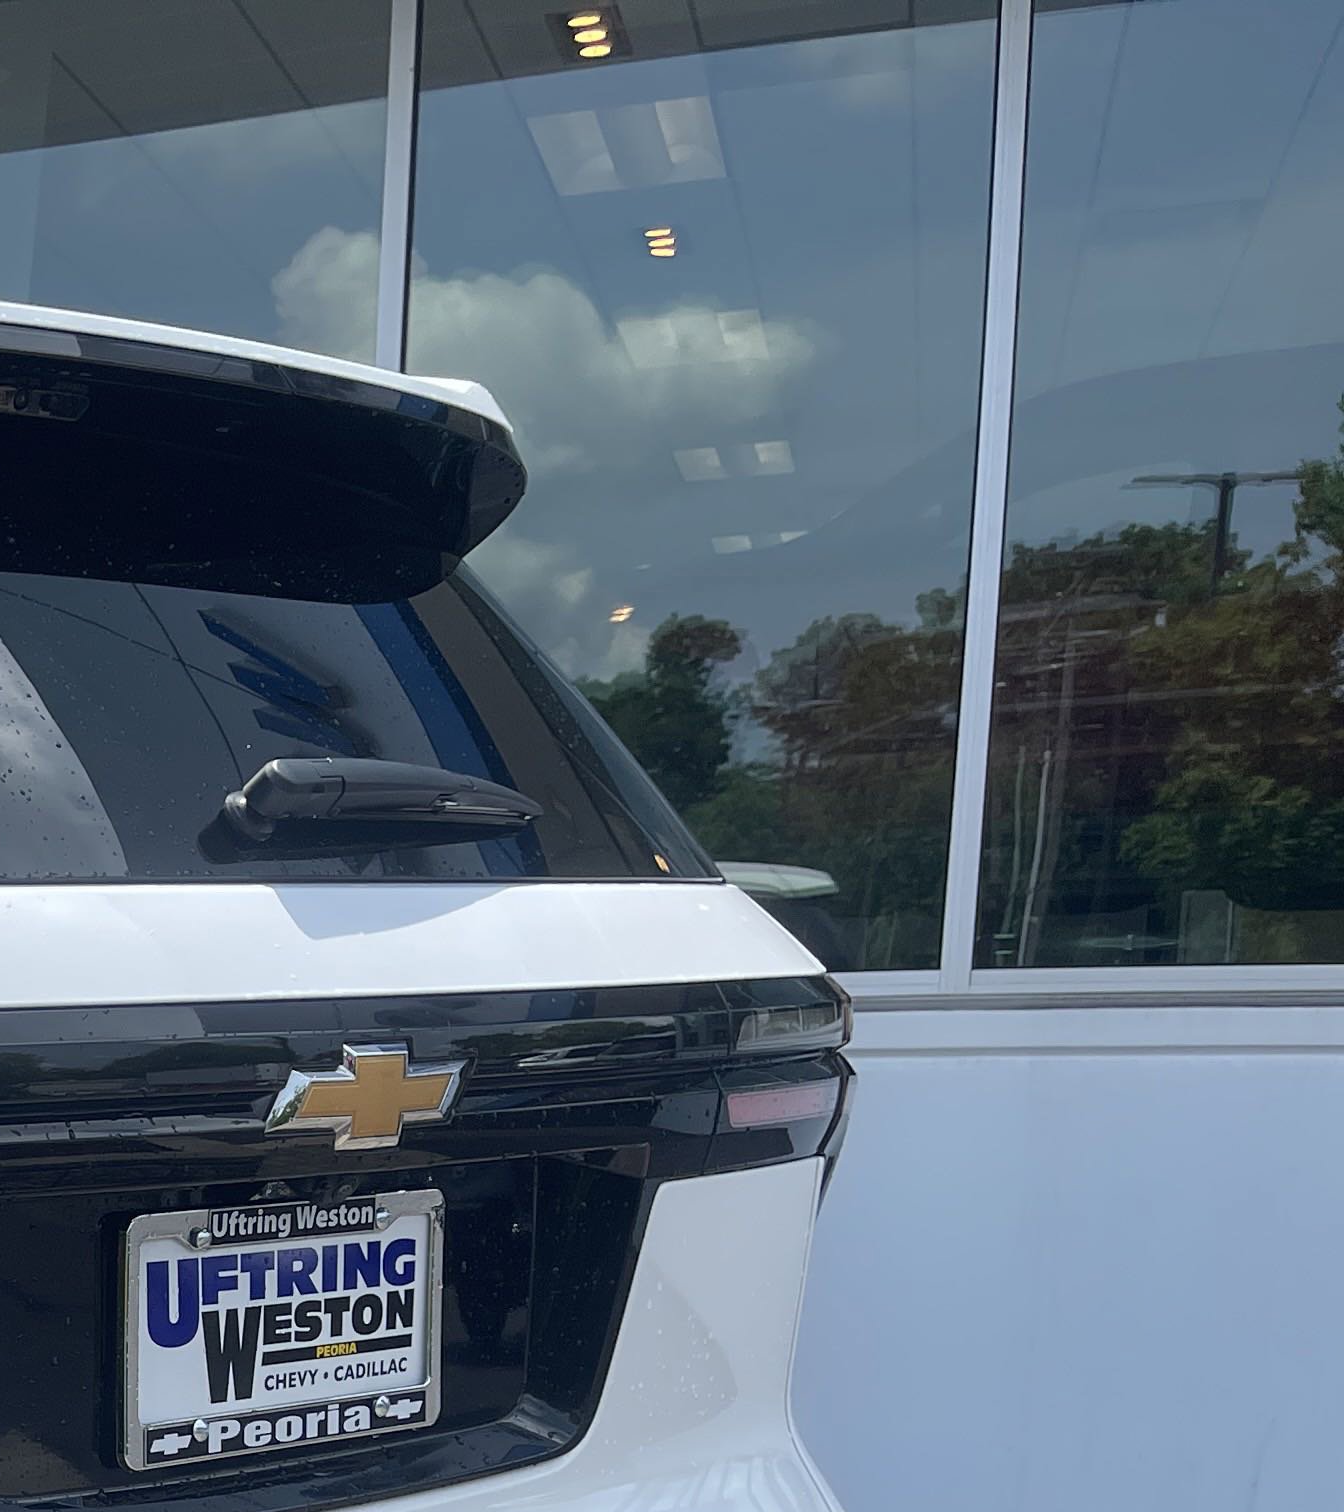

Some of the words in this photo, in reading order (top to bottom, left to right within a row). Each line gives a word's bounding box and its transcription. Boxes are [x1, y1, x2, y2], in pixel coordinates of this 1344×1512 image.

[212, 1208, 291, 1238] Uftring
[296, 1203, 374, 1229] Weston
[146, 1238, 416, 1348] UFTRING
[201, 1289, 415, 1404] WESTON
[315, 1342, 357, 1358] PEORIA
[264, 1368, 319, 1391] CHEVY
[334, 1357, 408, 1382] CADILLAC
[207, 1404, 371, 1454] Peoria
